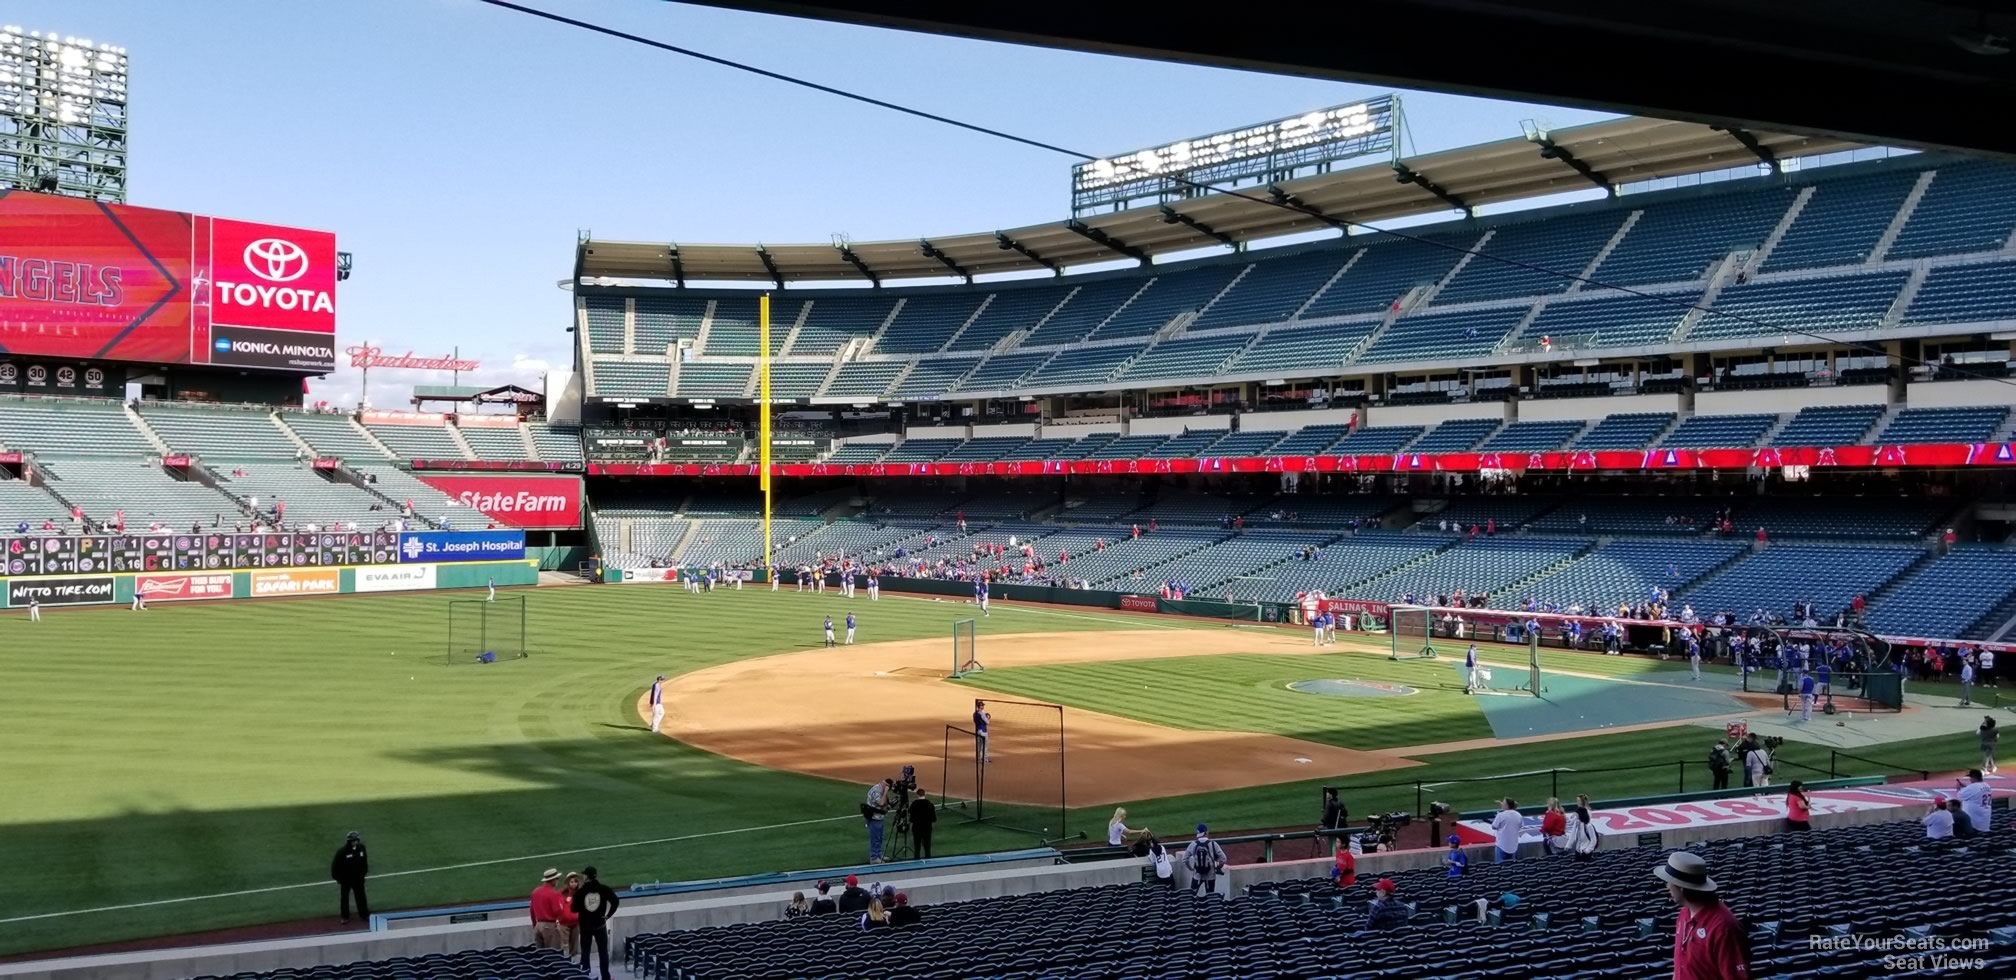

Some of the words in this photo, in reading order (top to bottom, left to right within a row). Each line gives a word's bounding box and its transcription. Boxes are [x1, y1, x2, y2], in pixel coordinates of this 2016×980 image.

[216, 281, 335, 314] TOYOTA
[232, 341, 281, 355] KONICA
[282, 344, 334, 358] MINOLTA
[346, 346, 480, 371] Budweiser
[0, 366, 15, 377] 29
[30, 368, 45, 378] 30
[59, 369, 73, 380] 42
[87, 371, 101, 381] 50
[162, 538, 170, 547] 4
[194, 538, 200, 547] 5
[224, 537, 231, 546] 5
[253, 537, 260, 546] 6
[282, 536, 288, 545] 6
[310, 536, 317, 545] 2
[335, 536, 345, 544] 11
[390, 534, 396, 543] 3
[30, 540, 37, 550] 6
[65, 540, 71, 549] 1
[98, 540, 105, 549] 7
[131, 539, 137, 548] 1
[426, 542, 440, 552] St.
[442, 541, 479, 553] Joseph
[481, 540, 523, 551] Hospital
[253, 556, 260, 565] 2
[282, 555, 288, 564] 5
[310, 555, 317, 563] 4
[337, 554, 343, 562] 7
[364, 553, 370, 562] 3
[389, 552, 396, 561] 4
[61, 561, 74, 571] 11
[97, 560, 105, 570] 4
[127, 559, 140, 569] 16
[162, 559, 169, 568] 6
[194, 558, 200, 567] 3
[224, 557, 230, 566] 1
[30, 562, 36, 572] 1
[190, 577, 207, 585] THIS
[13, 586, 51, 598] NITTO
[55, 583, 112, 596] TIRE.COM
[190, 585, 205, 593] FOR
[256, 581, 301, 593] SAFARI
[302, 579, 335, 591] PARK
[1131, 599, 1156, 608] TOYOTA
[1591, 799, 1782, 831] 2018
